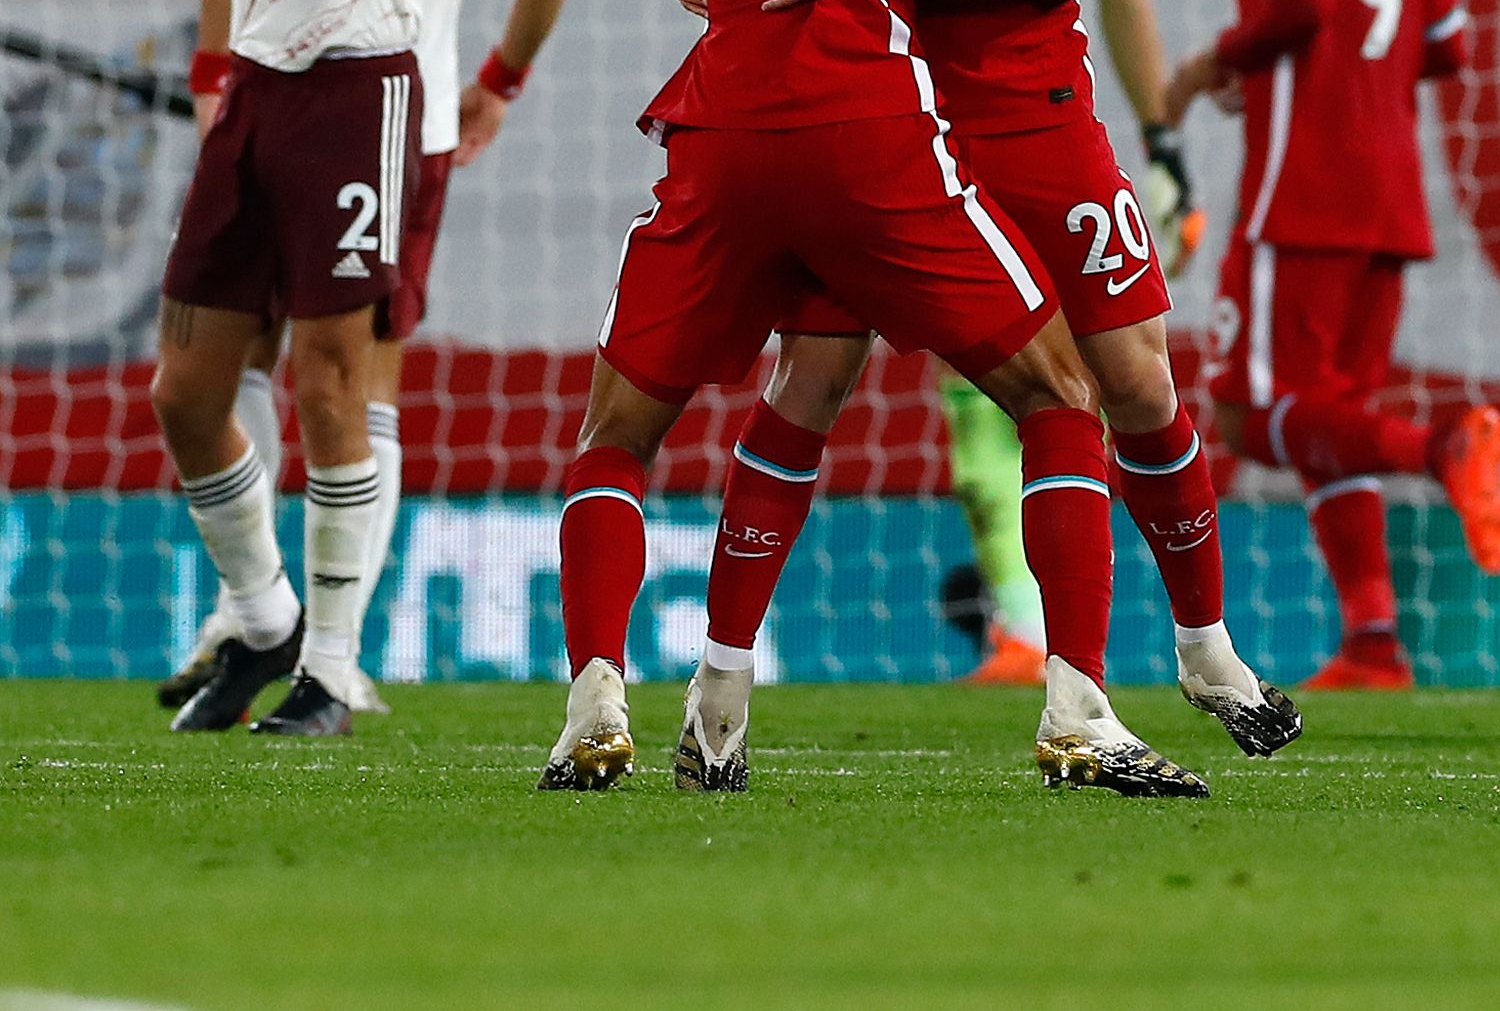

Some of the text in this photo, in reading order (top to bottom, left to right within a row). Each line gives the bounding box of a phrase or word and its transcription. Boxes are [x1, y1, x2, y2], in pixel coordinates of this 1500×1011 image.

[336, 181, 379, 250] 2
[1066, 188, 1149, 275] 20
[722, 517, 782, 546] L.F.C.
[1149, 509, 1215, 535] L.F.C.
